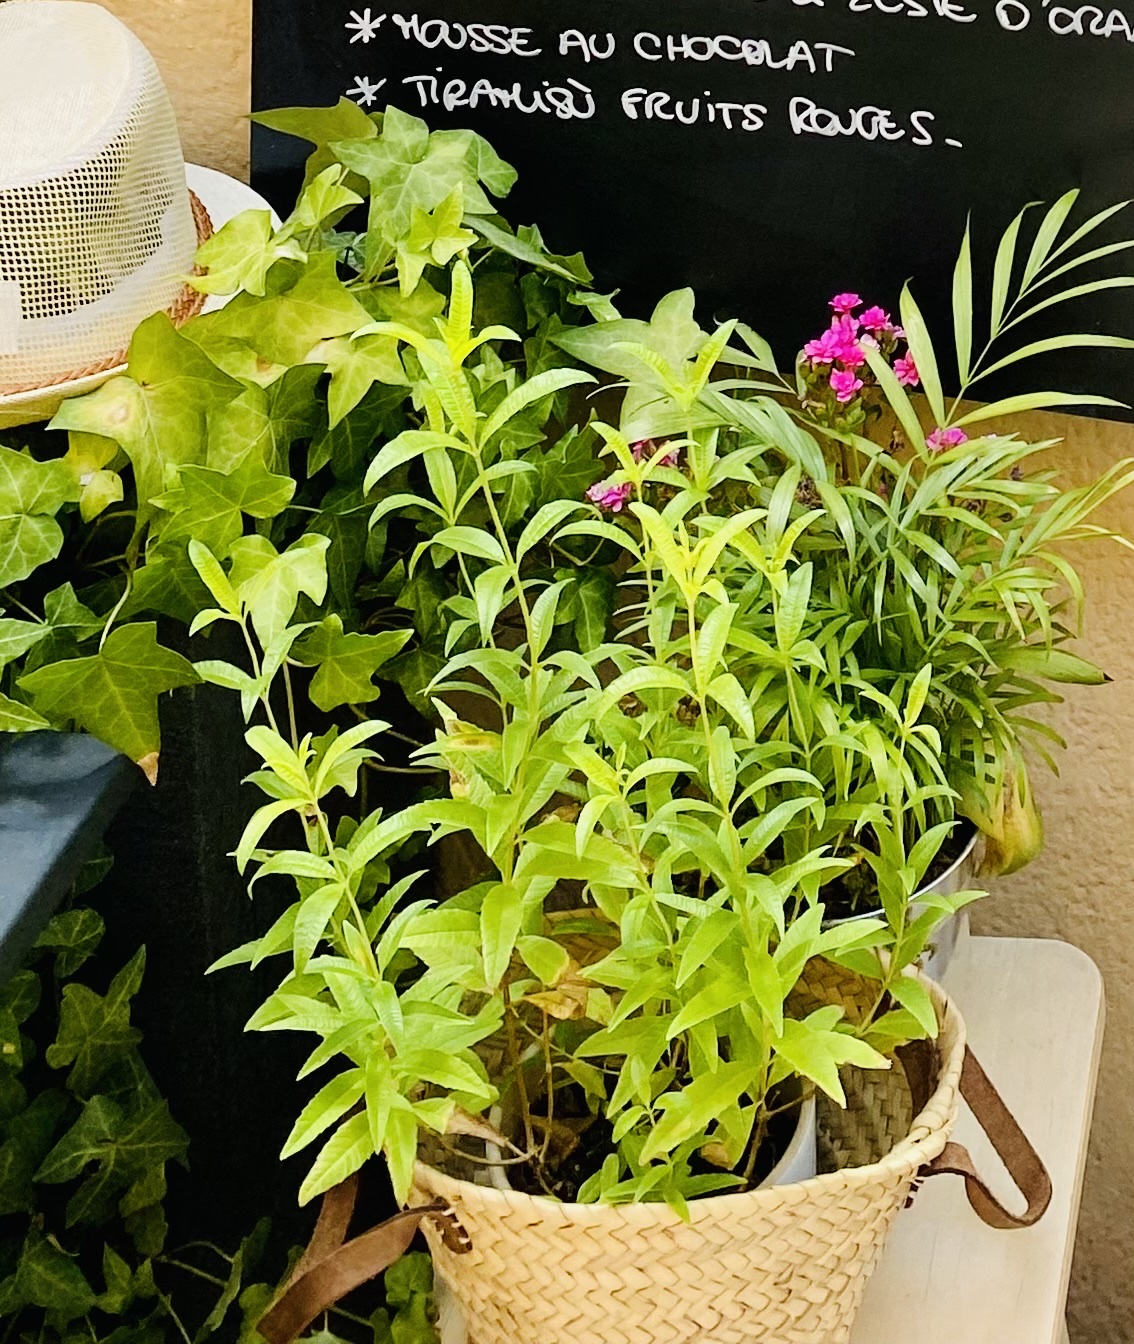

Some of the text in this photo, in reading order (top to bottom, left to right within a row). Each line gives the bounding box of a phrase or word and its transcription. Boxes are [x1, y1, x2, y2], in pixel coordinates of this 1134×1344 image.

[391, 13, 856, 73] MOUSSE AU CHOCOLAT
